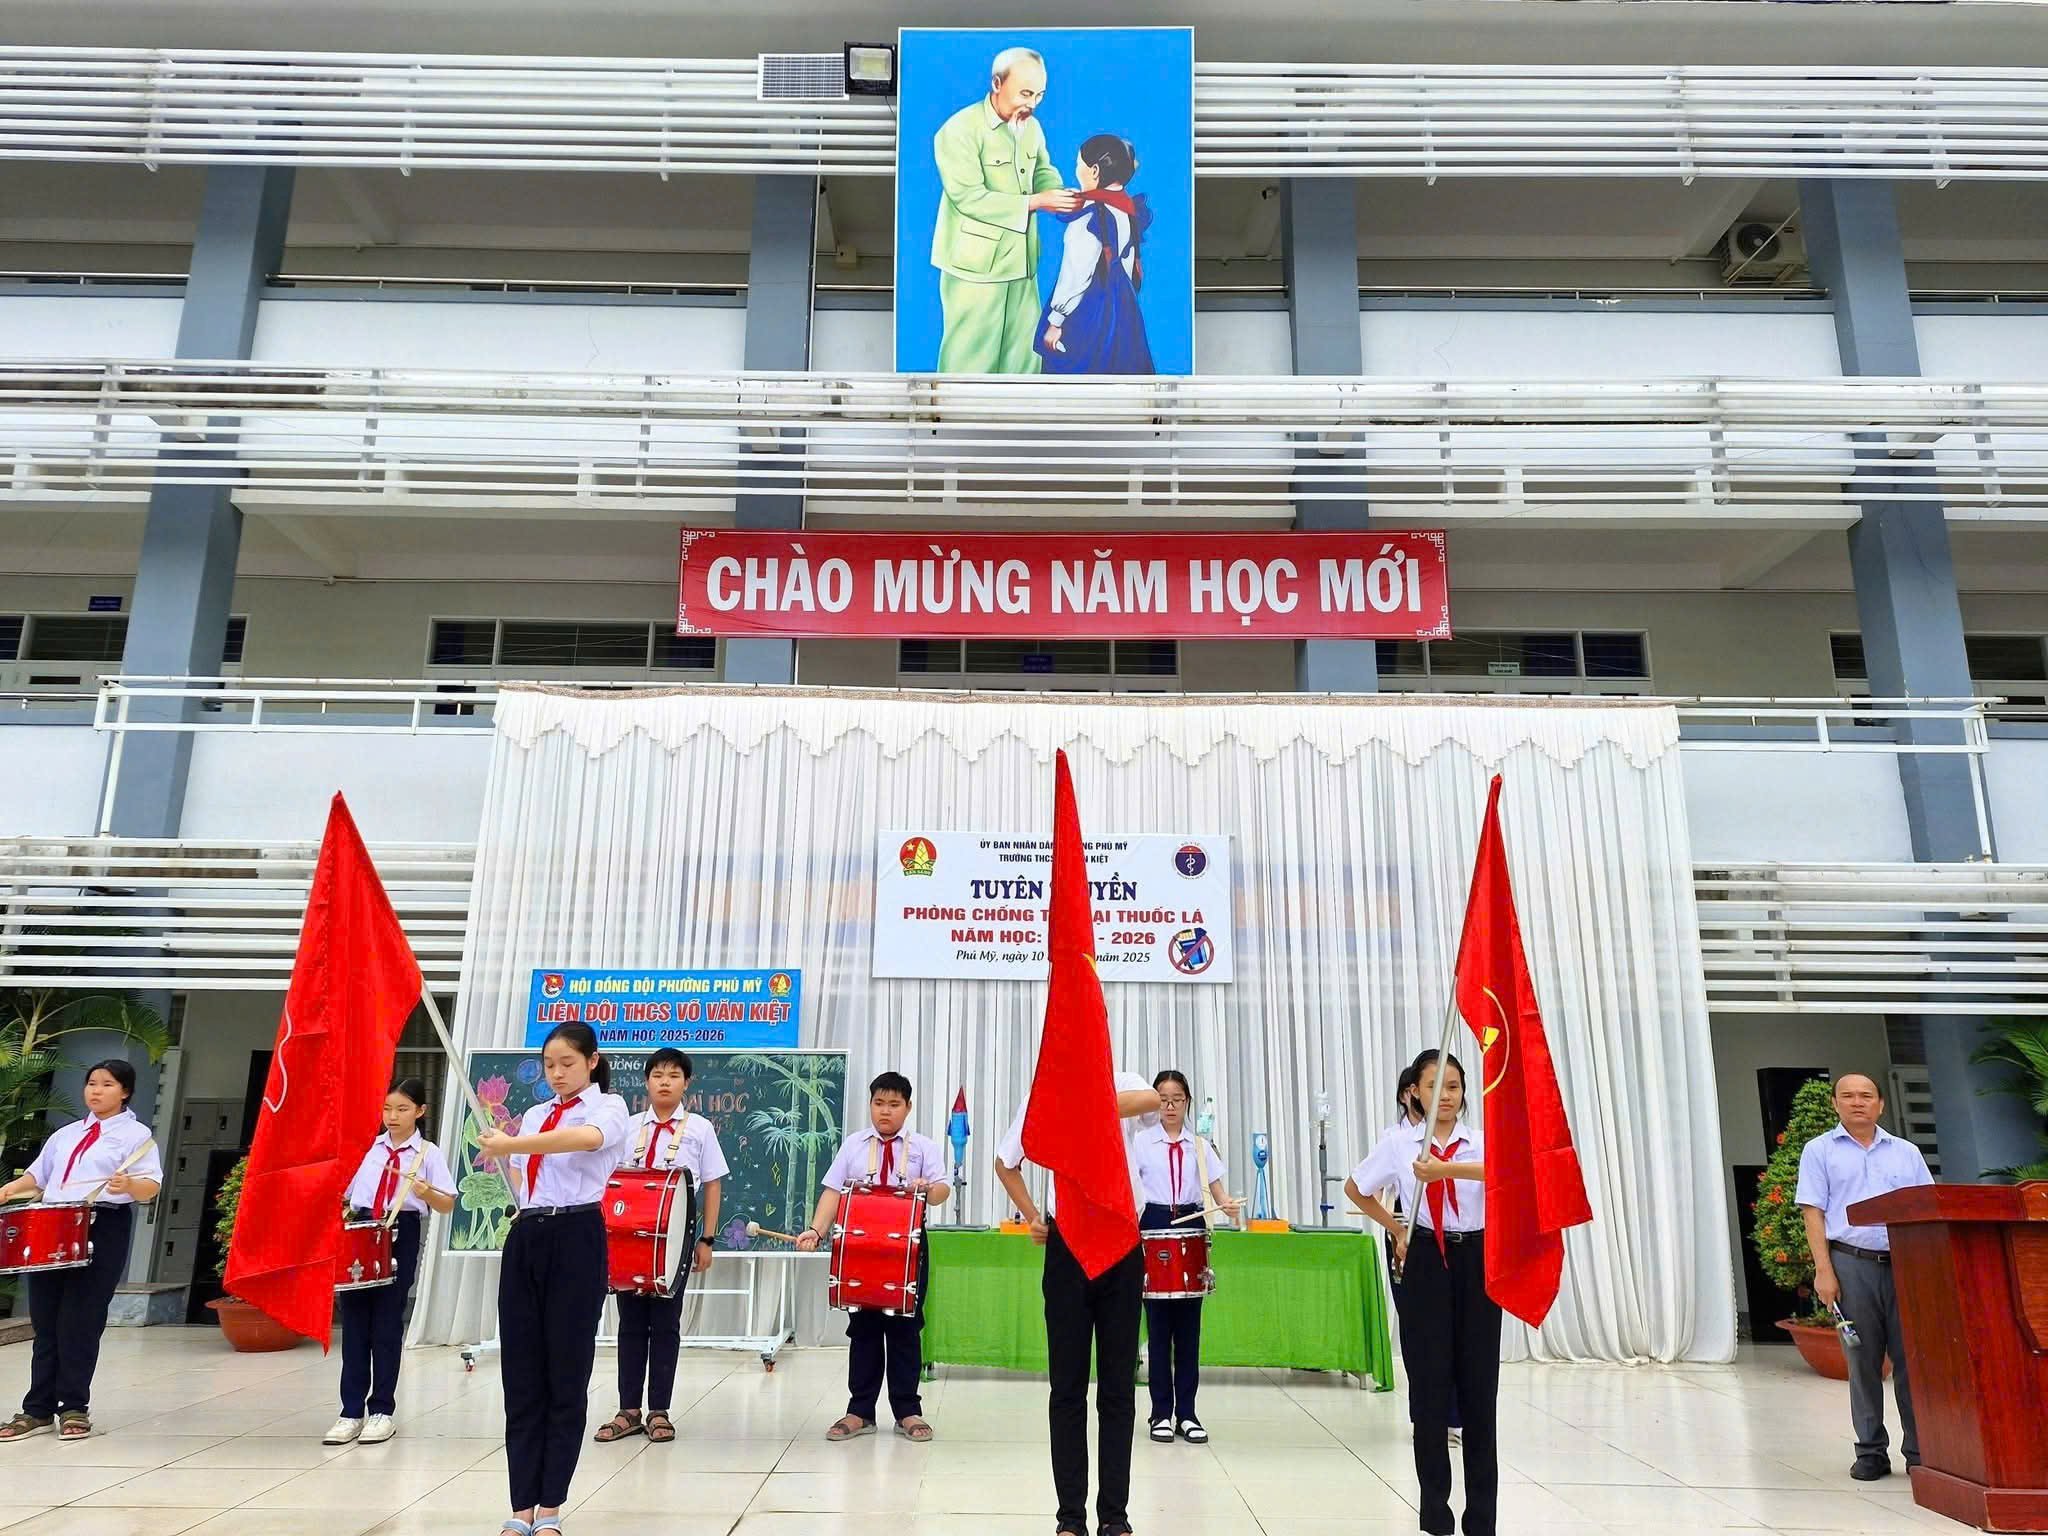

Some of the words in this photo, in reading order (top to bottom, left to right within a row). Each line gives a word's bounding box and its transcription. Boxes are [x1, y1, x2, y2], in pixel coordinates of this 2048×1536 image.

[706, 543, 853, 613] CHÀO
[874, 543, 1030, 614] MỪNG
[1052, 548, 1168, 614] NĂM
[1190, 558, 1299, 626] HỌC
[1320, 542, 1422, 613] MỚI
[993, 841, 1011, 850] BAN
[1013, 840, 1037, 850] NHÂN
[999, 853, 1032, 863] TRƯỜNG
[970, 874, 1044, 900] TUYÊN
[903, 904, 966, 921] PHÒNG
[971, 904, 1035, 922] CHỐNG
[1117, 906, 1176, 923] THUỐC
[1182, 907, 1204, 924] LÁ
[951, 927, 994, 943] NĂM
[999, 929, 1042, 946] HỌC:
[1111, 931, 1156, 945] 2026
[956, 949, 977, 961] Phú
[1002, 950, 1028, 964] ngày
[1031, 951, 1045, 962] 10
[1122, 951, 1151, 963] 2025
[569, 976, 592, 995] HỘI
[632, 976, 655, 995] ĐỘI
[658, 976, 710, 993] PHƯỜNG
[713, 976, 739, 993] PHÚ
[742, 976, 763, 993] MỸ
[537, 999, 580, 1023] LIÊN
[585, 999, 618, 1026] ĐỘI
[623, 1001, 671, 1022] THCS
[676, 999, 702, 1022] VÕ
[706, 999, 745, 1022] VĂN
[749, 999, 791, 1026] KIỆT
[600, 1027, 628, 1042] NĂM
[632, 1029, 656, 1045] HỌC
[660, 1029, 725, 1041] 2025-2026
